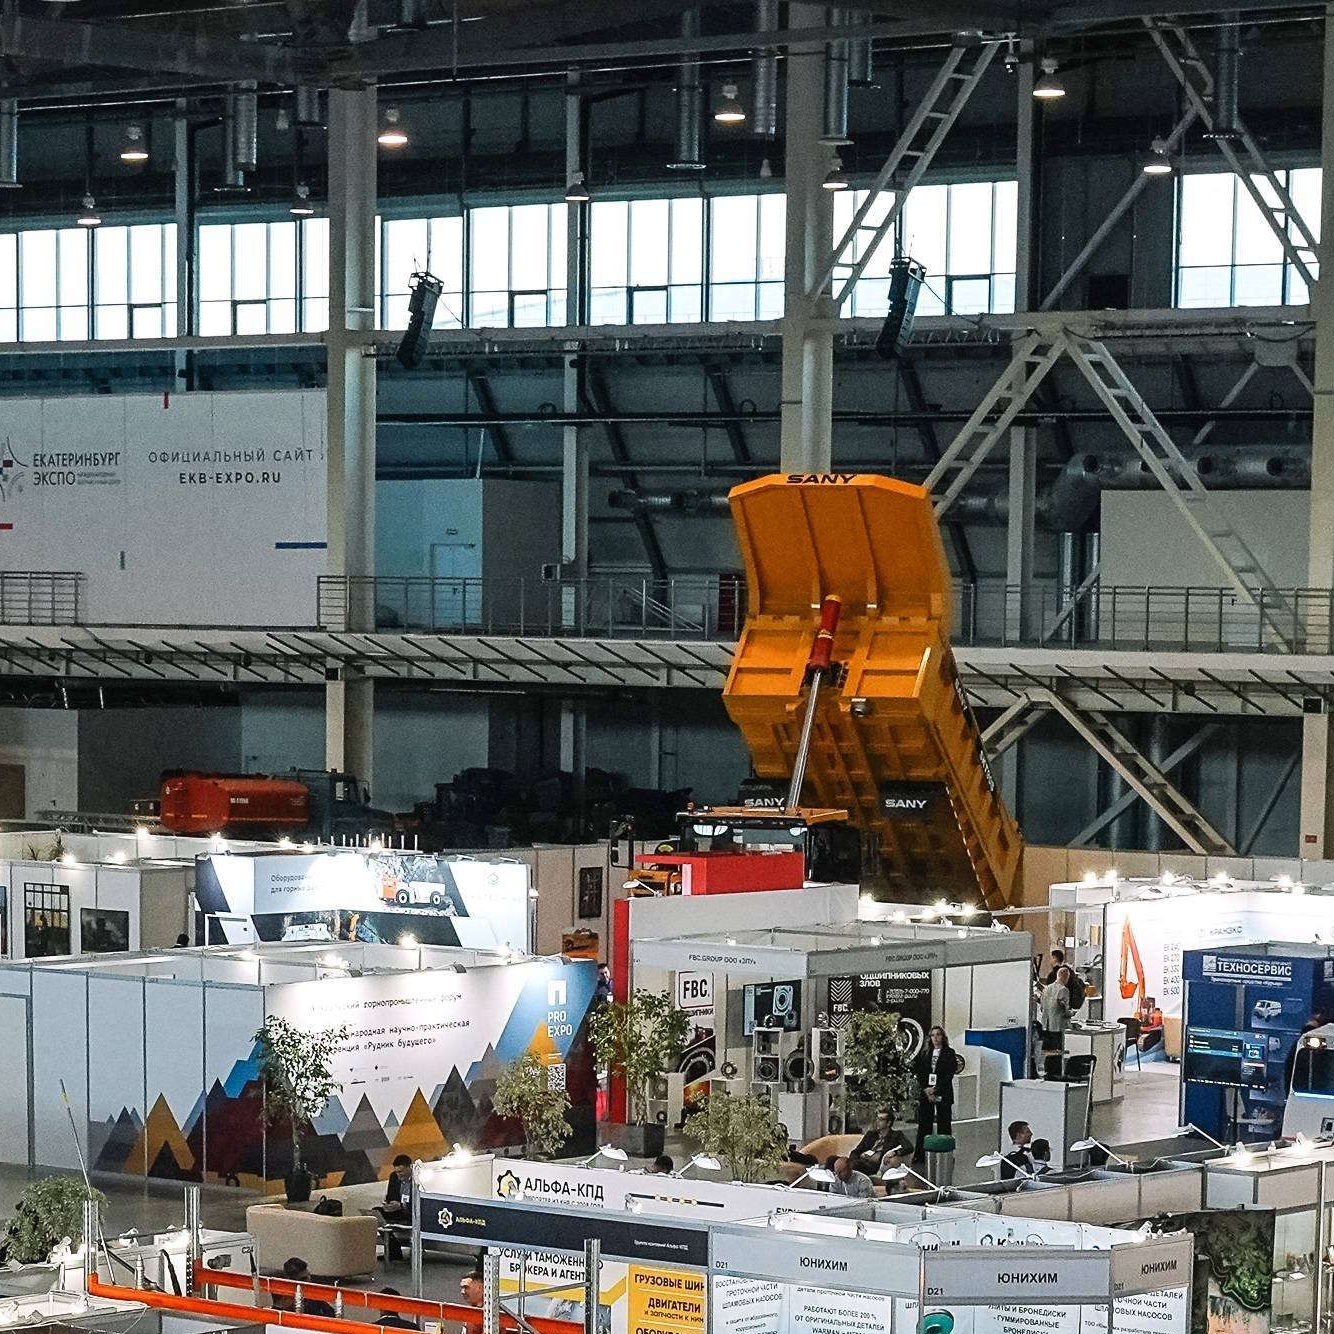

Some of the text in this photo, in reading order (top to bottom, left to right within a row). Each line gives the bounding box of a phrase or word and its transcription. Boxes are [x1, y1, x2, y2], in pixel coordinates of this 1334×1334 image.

[33, 453, 119, 467] ЕКАТЕРИНБУРГ
[149, 448, 312, 464] ОФИЦИАЛЬНЫЙ САЙТ
[33, 472, 75, 485] ЭКСПО
[180, 472, 280, 483] EKB-EXPO.RU
[786, 474, 856, 485] SANY
[744, 797, 784, 808] SANY
[885, 799, 927, 810] SANY
[1217, 961, 1291, 976] ТЕХНОСЕРВИС
[683, 978, 710, 999] FBC.
[547, 1010, 566, 1023] PRO
[547, 1025, 572, 1037] EXPO
[524, 1177, 604, 1201] АЛЬФА-КПД
[455, 1216, 486, 1226] АЛЬФА-КПД
[716, 1261, 728, 1269] D21
[800, 1257, 848, 1272] ЮНИХИМ
[1141, 1260, 1177, 1275] ЮНИХИМ
[997, 1272, 1058, 1284] ЮНИХИМ
[647, 1297, 701, 1314] ДВИГАТЕЛИ
[1144, 1300, 1167, 1309] ЧАСТИ
[803, 1305, 836, 1315] РАБОТАЮТ
[838, 1309, 859, 1318] БОЛЕЕ
[1019, 1307, 1067, 1318] БРОНЕДИСКИ
[1137, 1308, 1172, 1320] НАСОСОВ
[806, 1316, 856, 1329] ОРИГИНАЛЬНЫХ
[857, 1322, 885, 1331] ДЕТАЛЕЙ
[997, 1315, 1060, 1328] ГУММИРОВАННЫЕ
